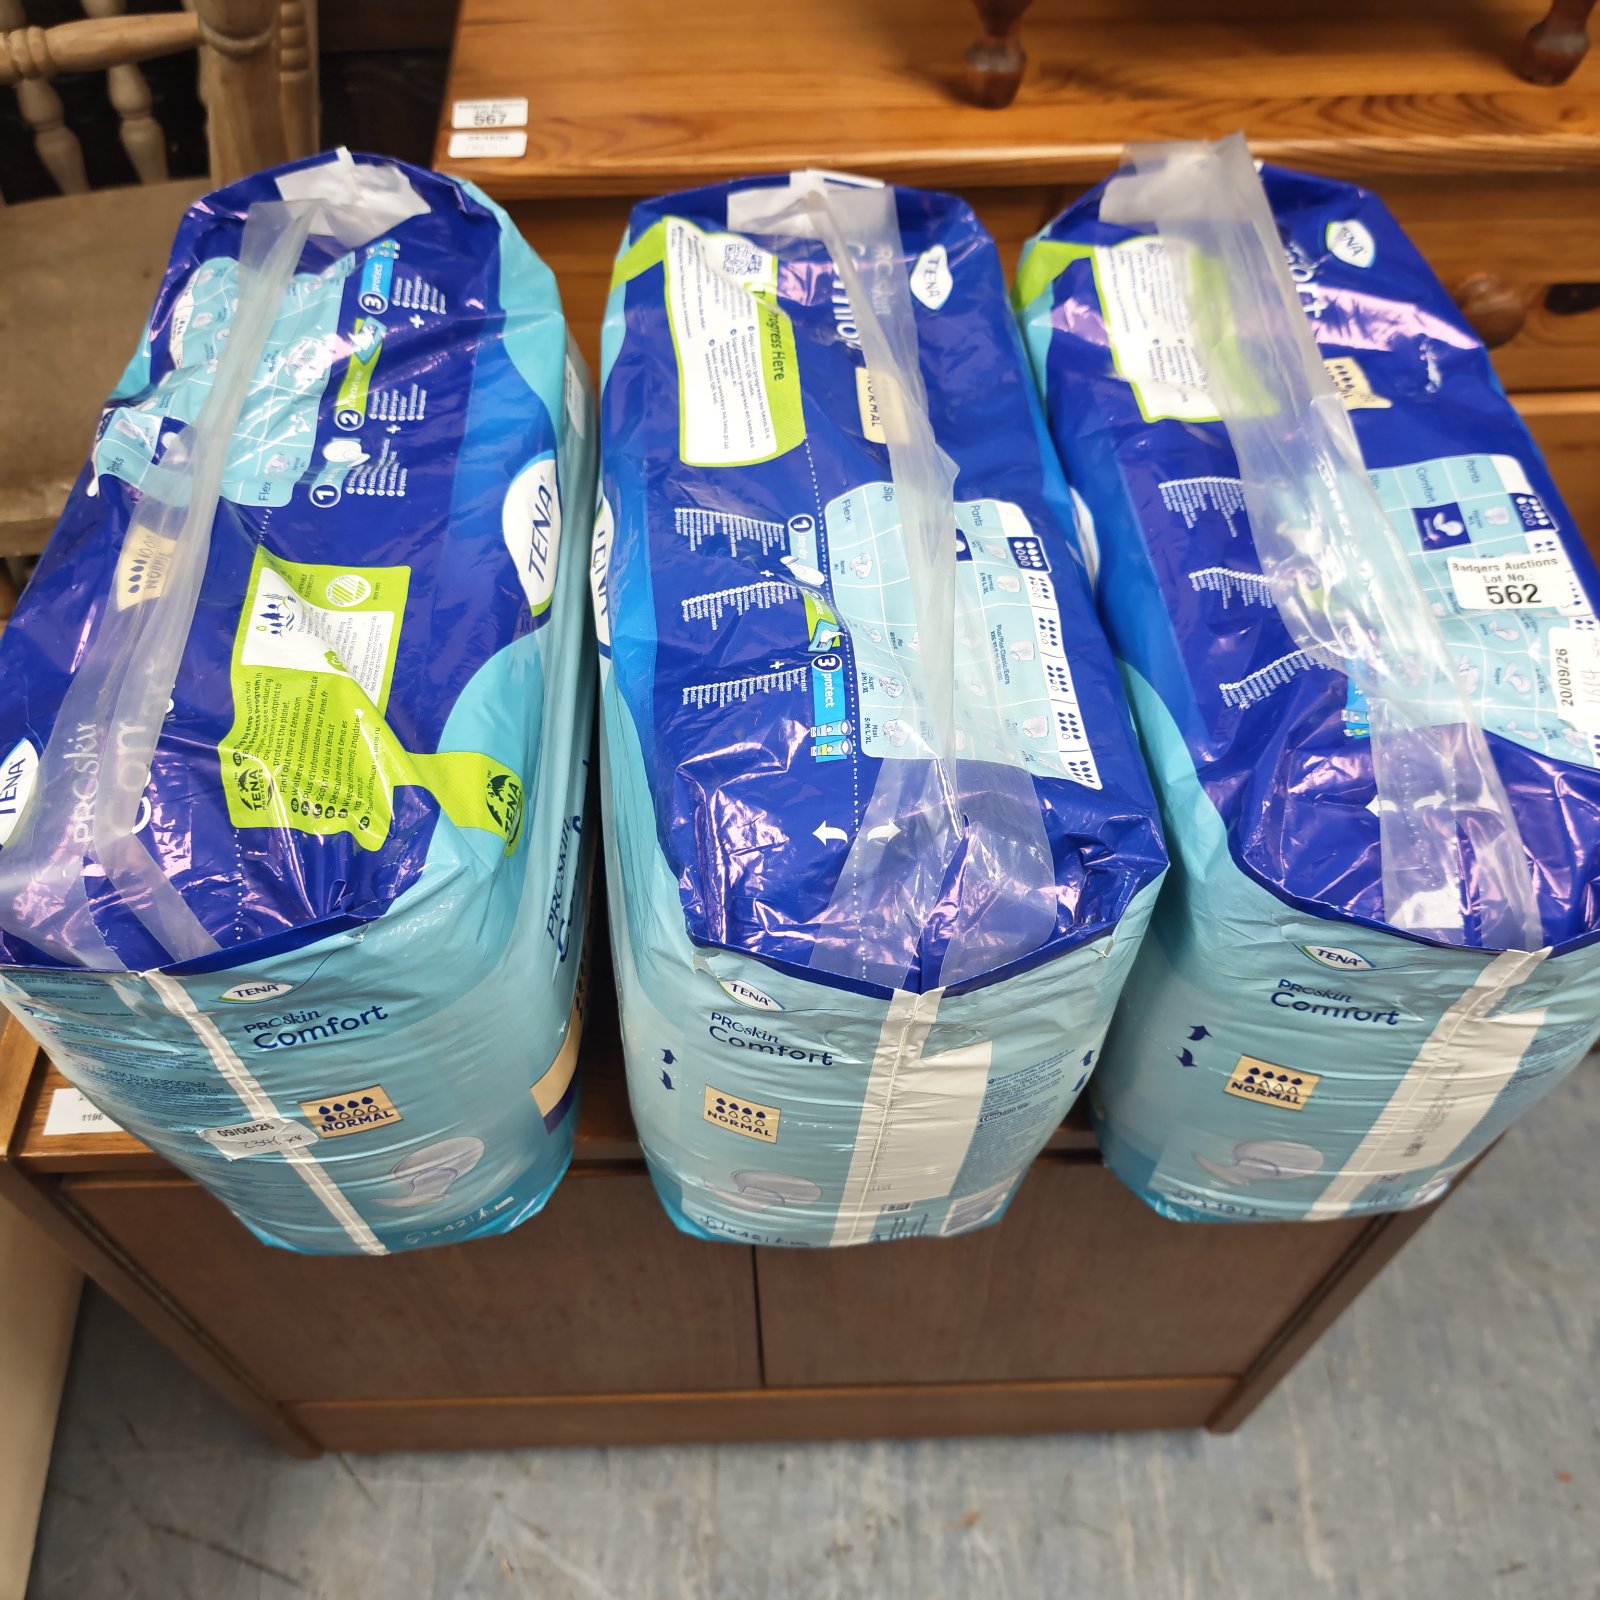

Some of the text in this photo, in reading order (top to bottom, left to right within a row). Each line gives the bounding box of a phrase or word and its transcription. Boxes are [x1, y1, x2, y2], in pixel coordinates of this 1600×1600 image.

[474, 114, 507, 126] 567
[364, 263, 384, 309] 3 protect
[924, 258, 940, 298] TENA
[772, 352, 785, 380] Here
[341, 412, 358, 425] 2
[1463, 460, 1481, 484] Pants
[258, 482, 272, 501] Flex
[316, 490, 334, 501] 1
[883, 487, 894, 501] Slip
[1416, 468, 1435, 504] Comfort
[842, 499, 852, 523] Flex
[970, 505, 984, 527] Pants
[528, 486, 551, 583] TENA
[794, 522, 810, 559] 1 stay dry
[1452, 557, 1557, 573] Badgers Auctions
[1483, 574, 1503, 583] Lot
[1486, 584, 1541, 605] 562
[308, 676, 318, 699] tena.de
[818, 657, 835, 708] 3 protect
[1555, 648, 1574, 707] 20/09/26
[263, 679, 273, 707] reducing
[289, 697, 301, 728] tena.com
[306, 700, 314, 712] auf
[273, 738, 283, 765] protect
[280, 701, 290, 723] planet.
[289, 729, 296, 737] at
[303, 691, 329, 798] Plus d'informations sur tena.fr
[326, 724, 335, 746] tena.it
[338, 721, 348, 745] tena.es
[286, 738, 294, 757] more
[325, 748, 331, 756] su
[282, 759, 291, 772] out
[334, 757, 342, 770] más
[348, 750, 356, 783] informacji
[249, 770, 262, 811] TENA
[258, 769, 266, 811] PROTECTS
[291, 764, 304, 795] Weitere
[329, 771, 341, 804] Descubre
[354, 801, 362, 810] na
[503, 782, 520, 834] TENA
[1316, 948, 1361, 967] TENA
[234, 983, 278, 999] TENA
[730, 983, 769, 1006] TENA
[1278, 979, 1352, 1003] PROskin
[243, 1007, 322, 1034] PROskin
[1270, 992, 1400, 1026] Comfort
[252, 1004, 389, 1050] Comfort
[711, 1012, 778, 1044] PROskin
[708, 1025, 833, 1067] Comfort
[1231, 1081, 1302, 1105] NORMAL
[217, 1123, 274, 1137] 09/08/26
[320, 1109, 395, 1133] NORMAL
[707, 1110, 772, 1138] NORMAL
